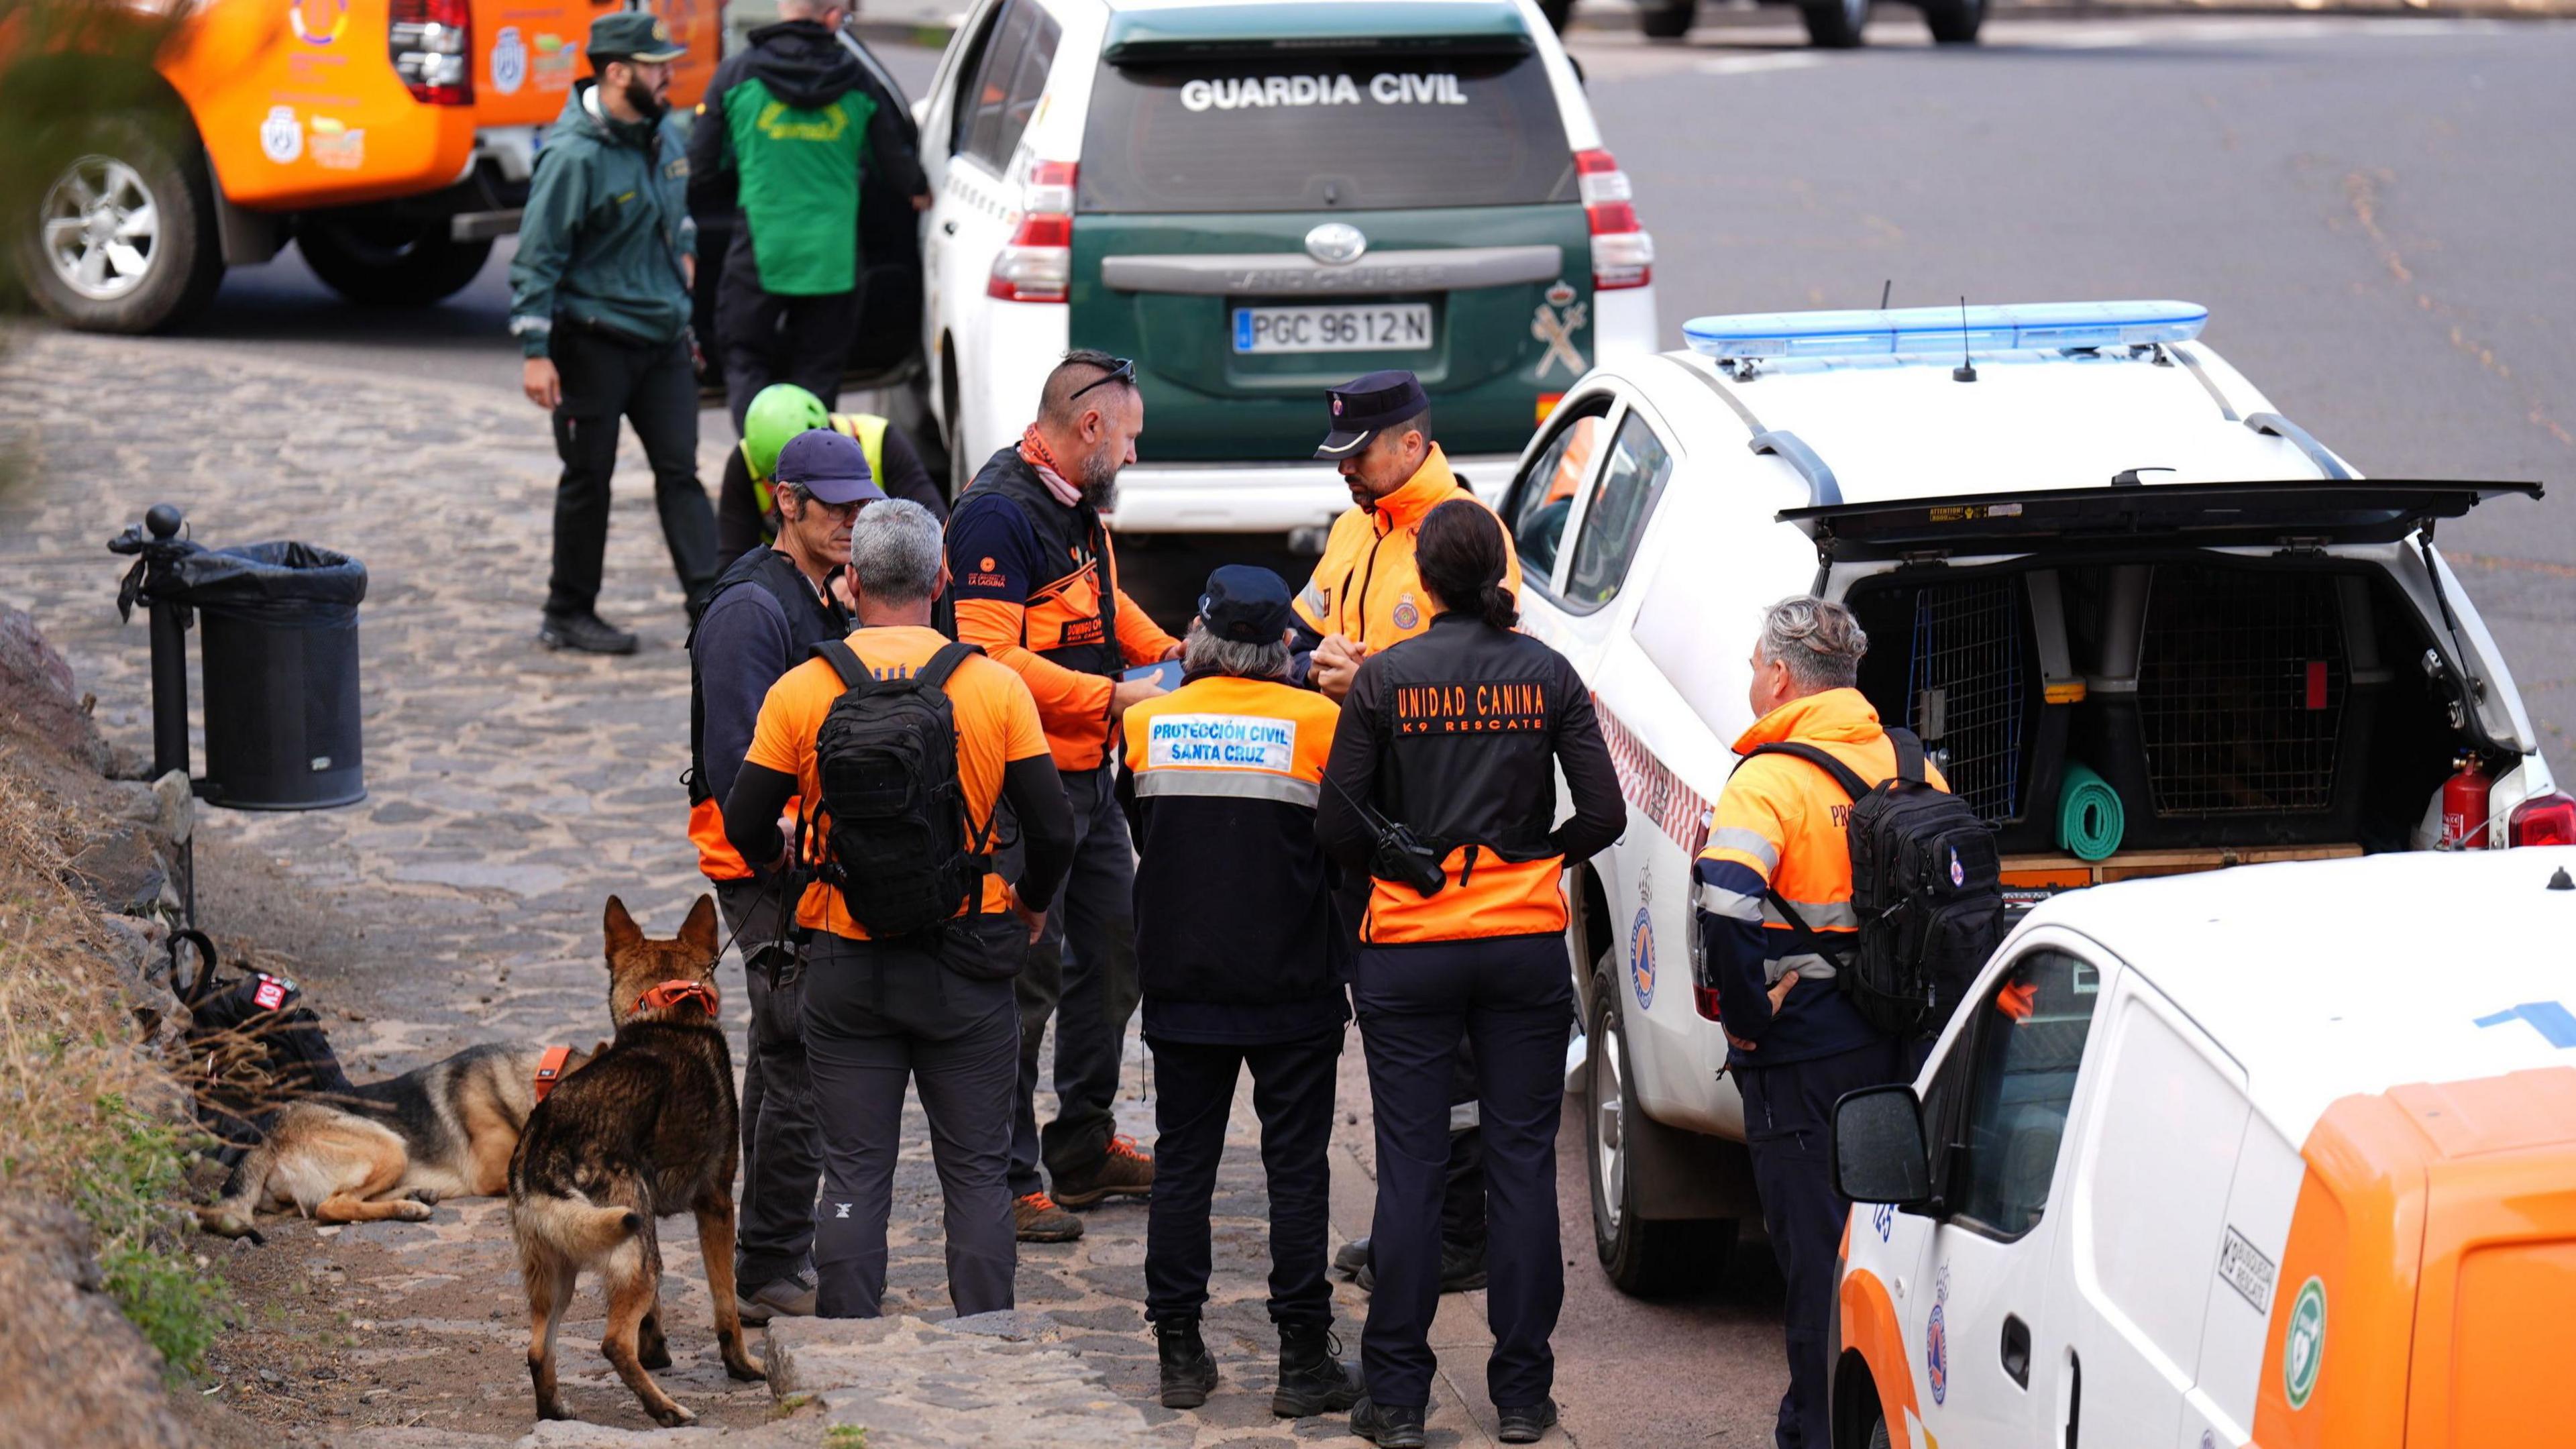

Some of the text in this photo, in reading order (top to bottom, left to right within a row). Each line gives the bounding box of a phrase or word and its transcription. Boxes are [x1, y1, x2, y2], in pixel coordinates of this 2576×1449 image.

[1181, 73, 1468, 111] GUARDIA CIVIL
[1253, 315, 1310, 345] PGC
[1398, 684, 1544, 718] UNIDAD CANINA
[1153, 720, 1288, 745] PROTECCIÓN CIVIL
[1403, 718, 1542, 733] K9 RESCATE
[1171, 743, 1266, 763] SANTA CRUZ
[258, 983, 282, 1008] K9
